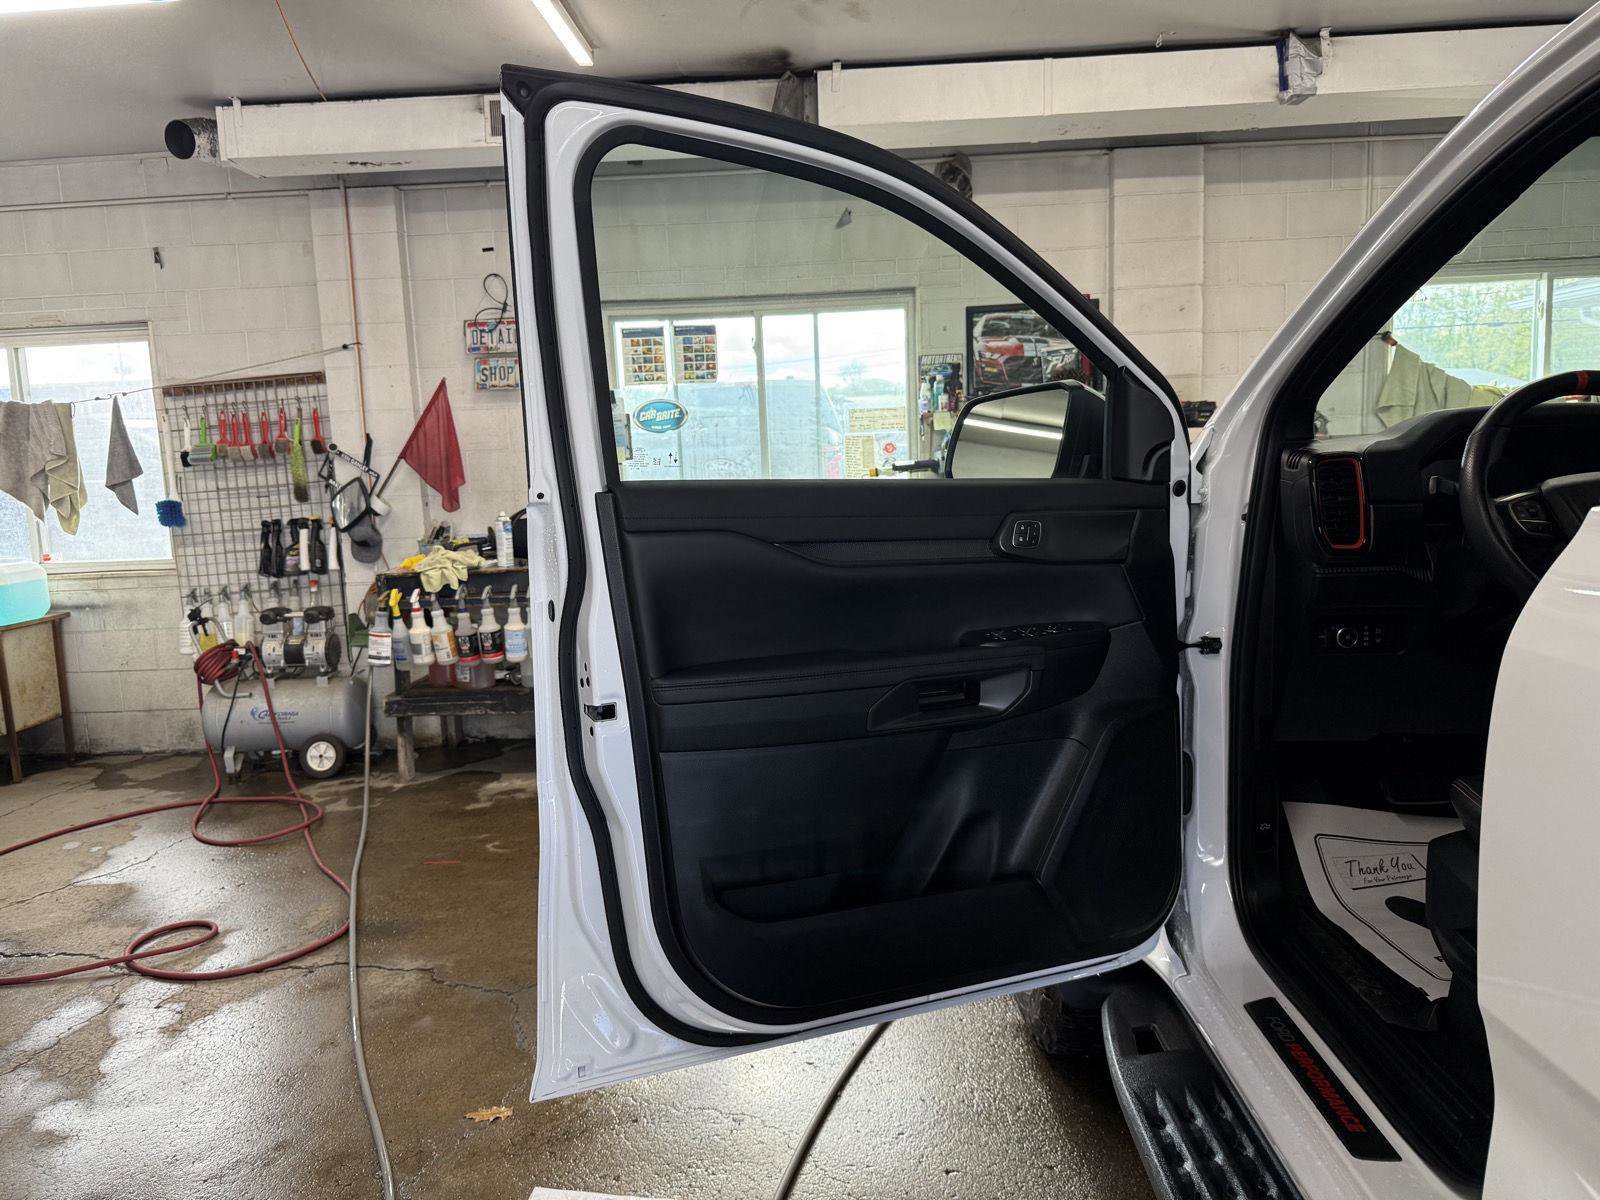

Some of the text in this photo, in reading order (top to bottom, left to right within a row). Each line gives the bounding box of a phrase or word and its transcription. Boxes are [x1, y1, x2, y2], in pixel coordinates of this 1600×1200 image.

[481, 366, 514, 383] SHOP
[639, 408, 681, 421] CAR BRITE
[1344, 857, 1415, 877] Thank You
[1264, 1016, 1367, 1133] FORD PERFORMANCE
